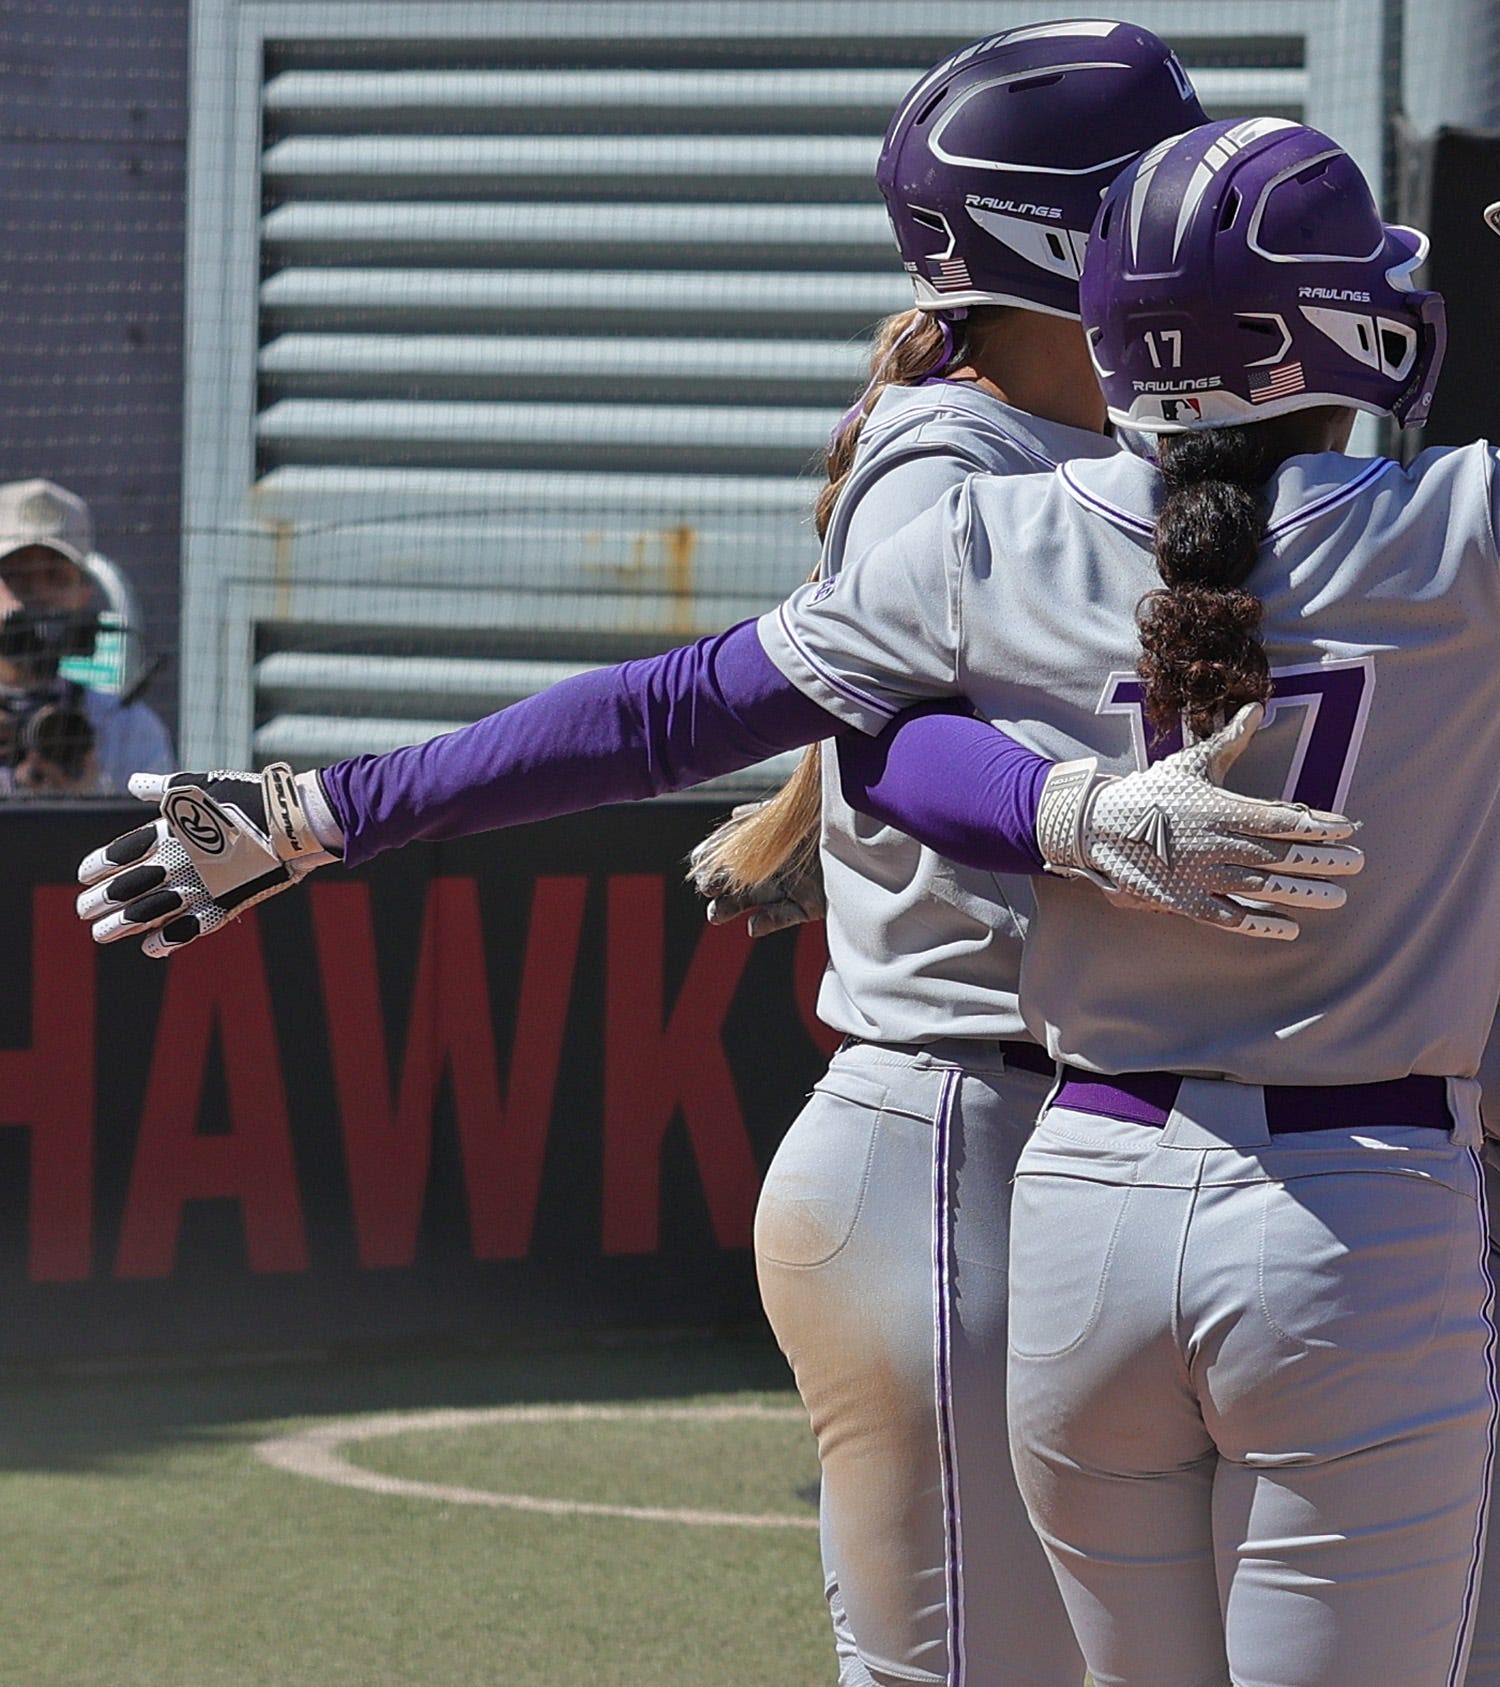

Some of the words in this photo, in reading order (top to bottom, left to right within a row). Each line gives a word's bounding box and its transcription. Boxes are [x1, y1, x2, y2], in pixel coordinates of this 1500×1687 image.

[965, 194, 1063, 219] RAWLINGS
[1299, 286, 1371, 302] RAWLINGS
[1143, 329, 1183, 368] 17
[1132, 375, 1223, 392] RAWLINGS
[271, 771, 303, 852] RAWLINGS
[0, 872, 832, 1283] HAWK
